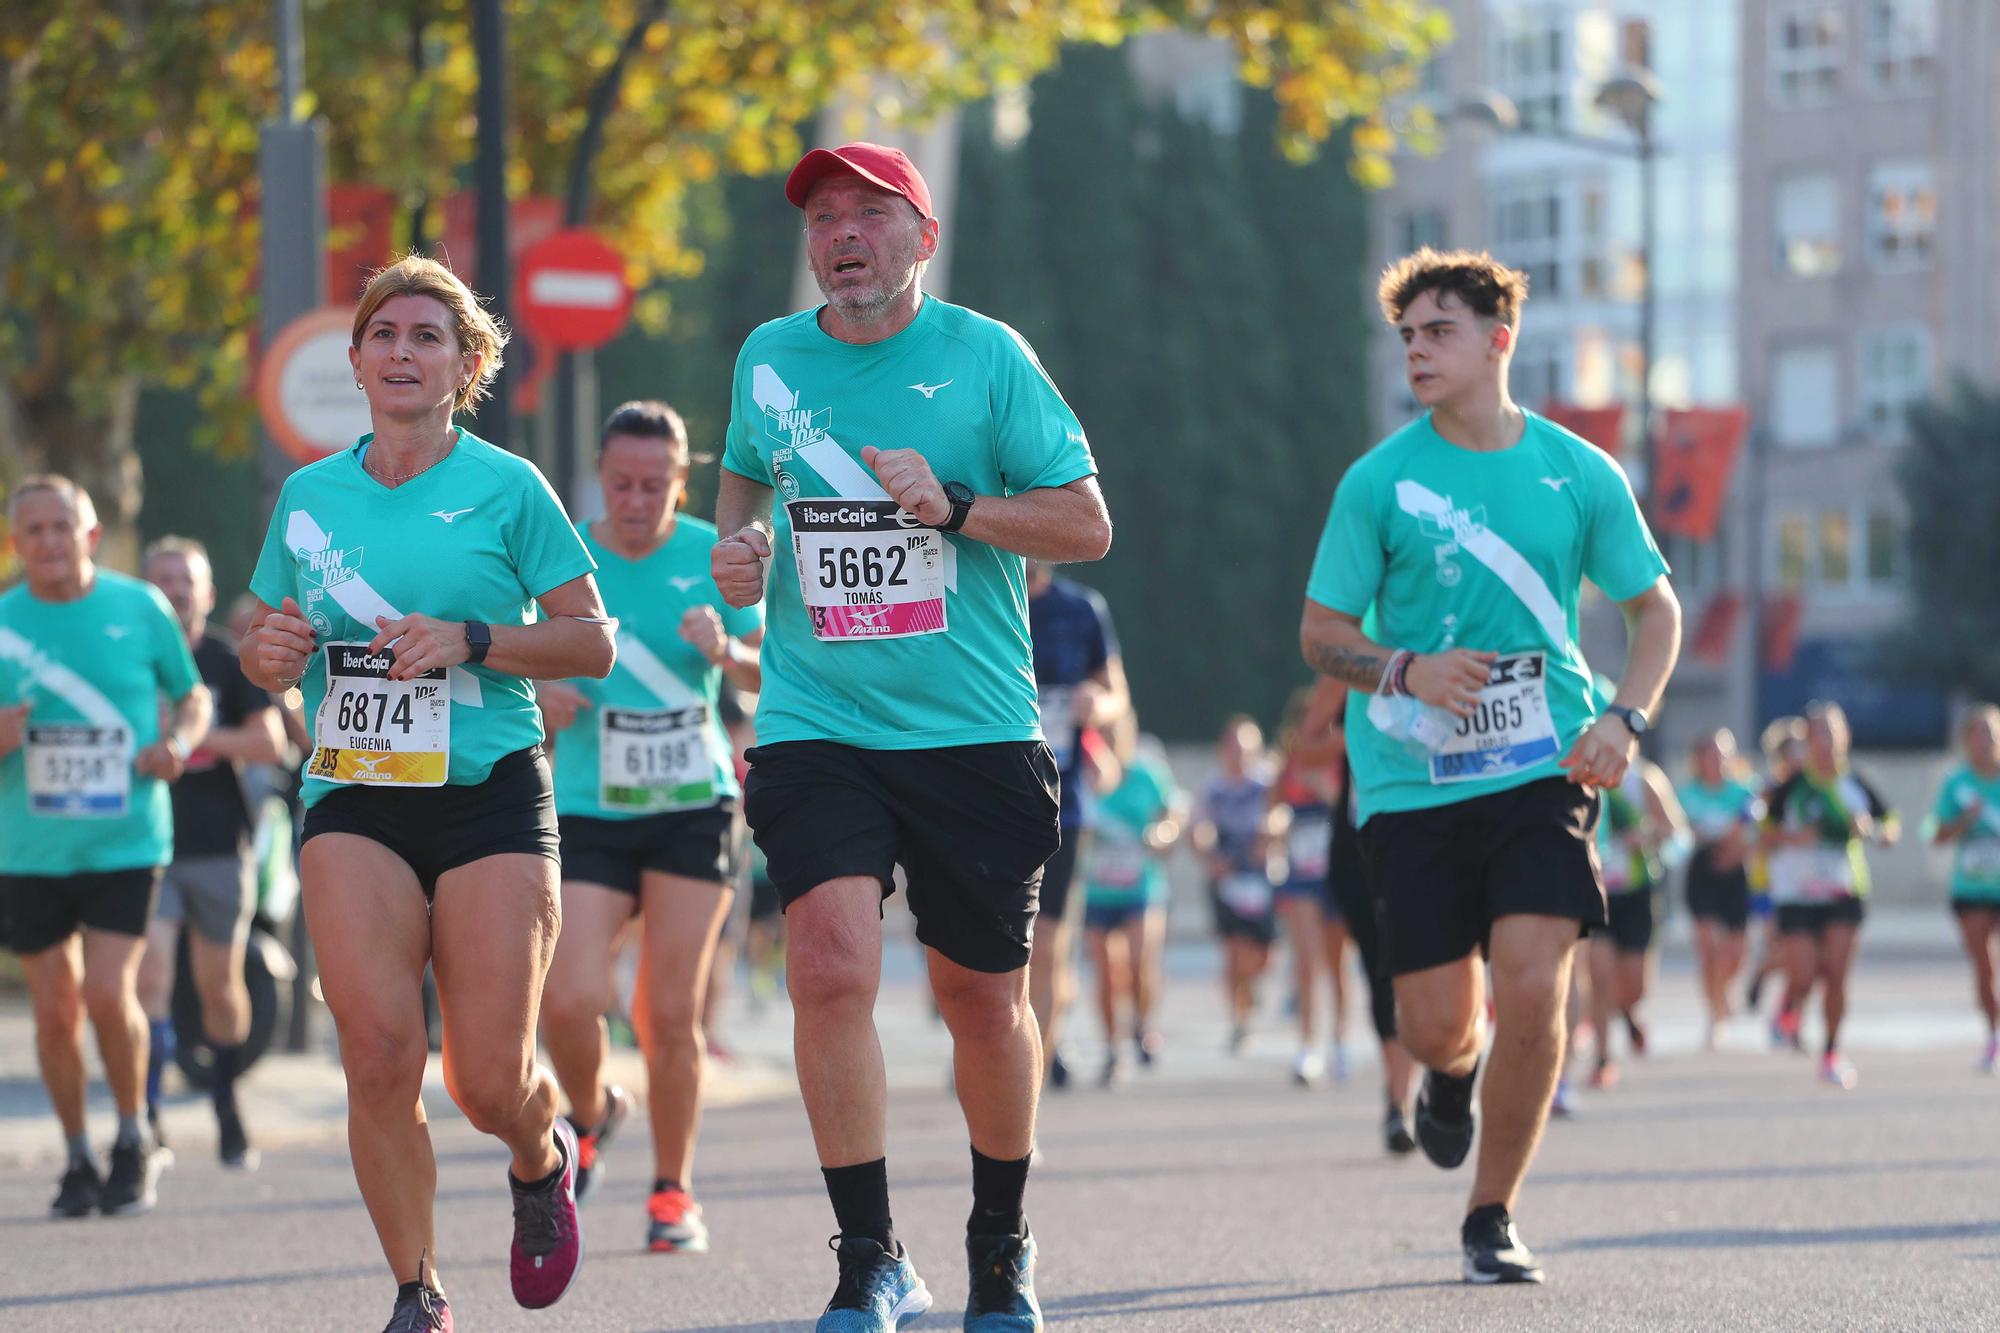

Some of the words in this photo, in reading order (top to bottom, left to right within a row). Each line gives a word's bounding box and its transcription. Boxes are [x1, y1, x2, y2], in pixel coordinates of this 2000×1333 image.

[778, 409, 812, 431] RUN
[803, 507, 878, 527] iberCaja
[906, 535, 930, 550] 10K
[310, 549, 344, 571] RUN
[818, 545, 908, 588] 5662
[844, 589, 883, 605] TOMÁS
[343, 652, 390, 673] iberCaja
[415, 686, 438, 699] 10K
[337, 691, 414, 734] 6874
[350, 736, 392, 751] EUGENIA
[321, 747, 340, 771] 03
